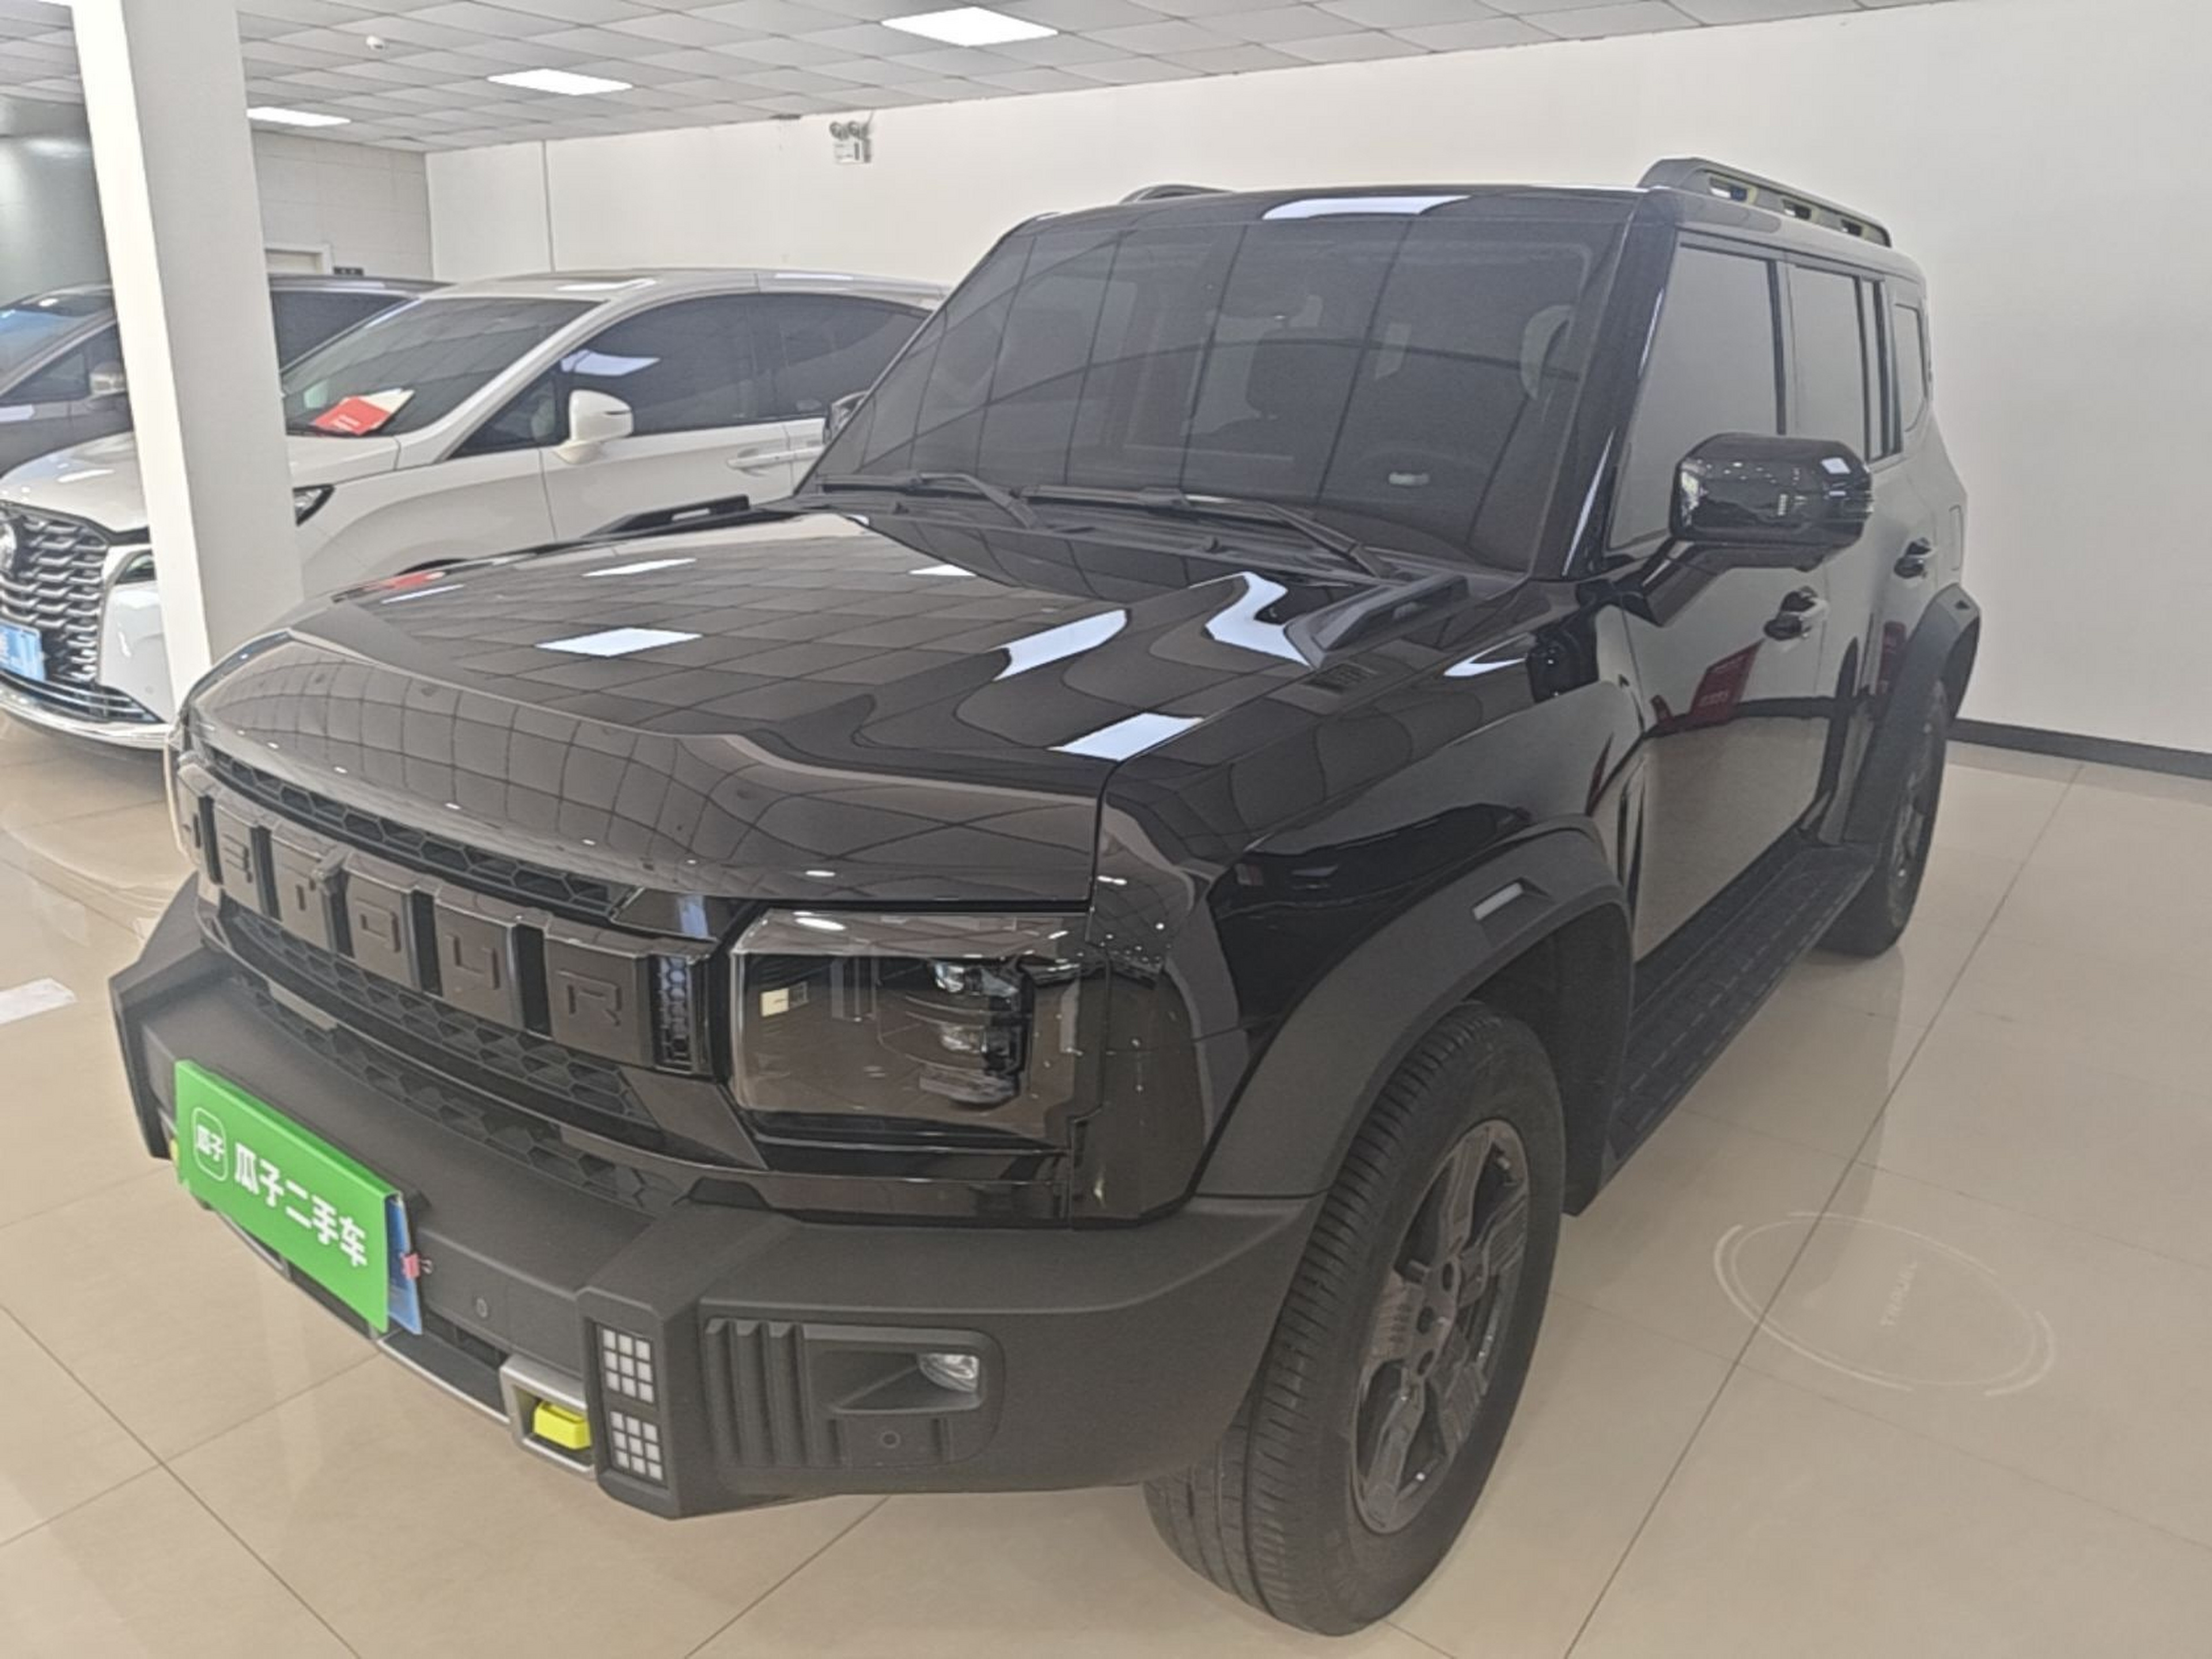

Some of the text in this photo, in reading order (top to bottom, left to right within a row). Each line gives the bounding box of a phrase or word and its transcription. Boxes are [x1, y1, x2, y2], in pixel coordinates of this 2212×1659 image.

[234, 1142, 368, 1267] 瓜子二手车
